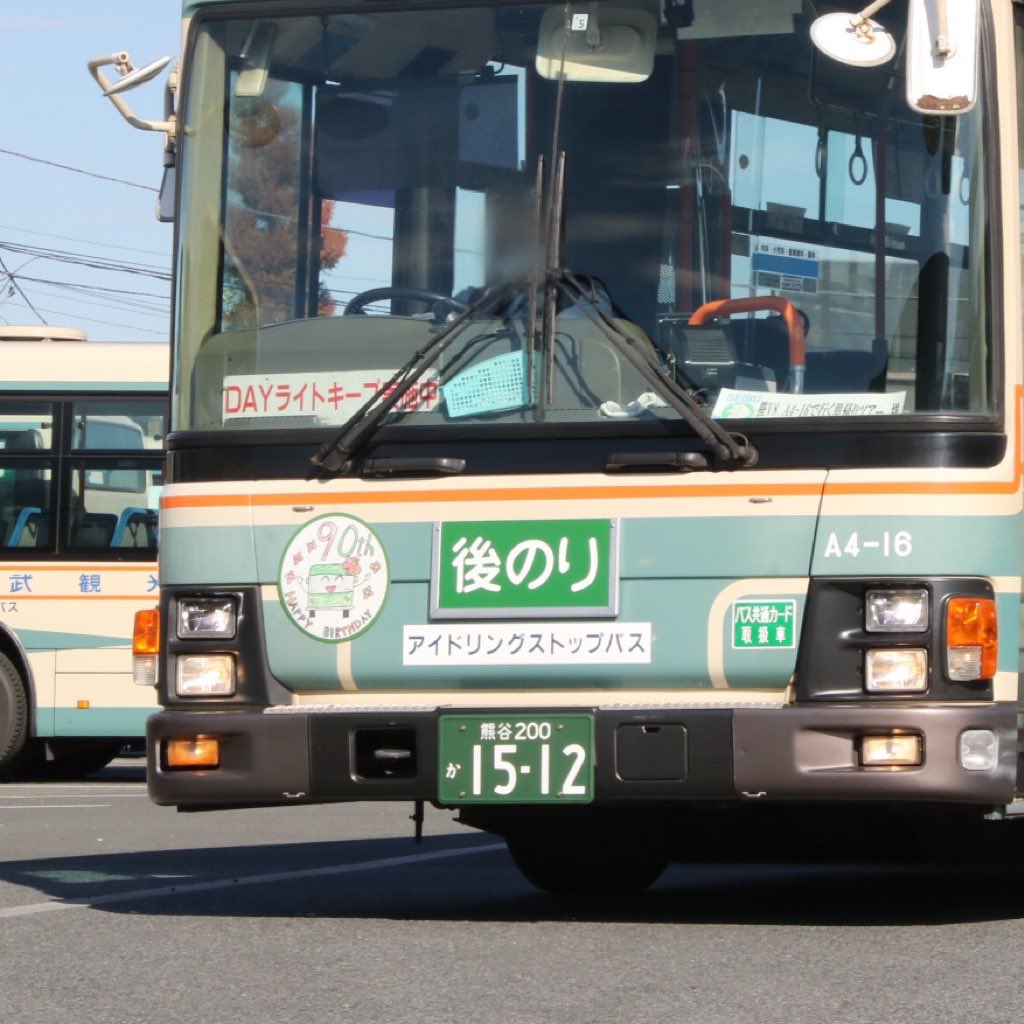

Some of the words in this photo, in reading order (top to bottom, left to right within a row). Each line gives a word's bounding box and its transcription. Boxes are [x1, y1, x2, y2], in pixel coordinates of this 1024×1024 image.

[317, 521, 375, 562] 90th
[823, 530, 913, 558] A4-16
[451, 536, 599, 594] 後のり
[407, 632, 646, 657] アイドリングストップバス
[479, 721, 552, 741] 熊谷200
[445, 762, 462, 780] か
[472, 743, 587, 796] 15-12
